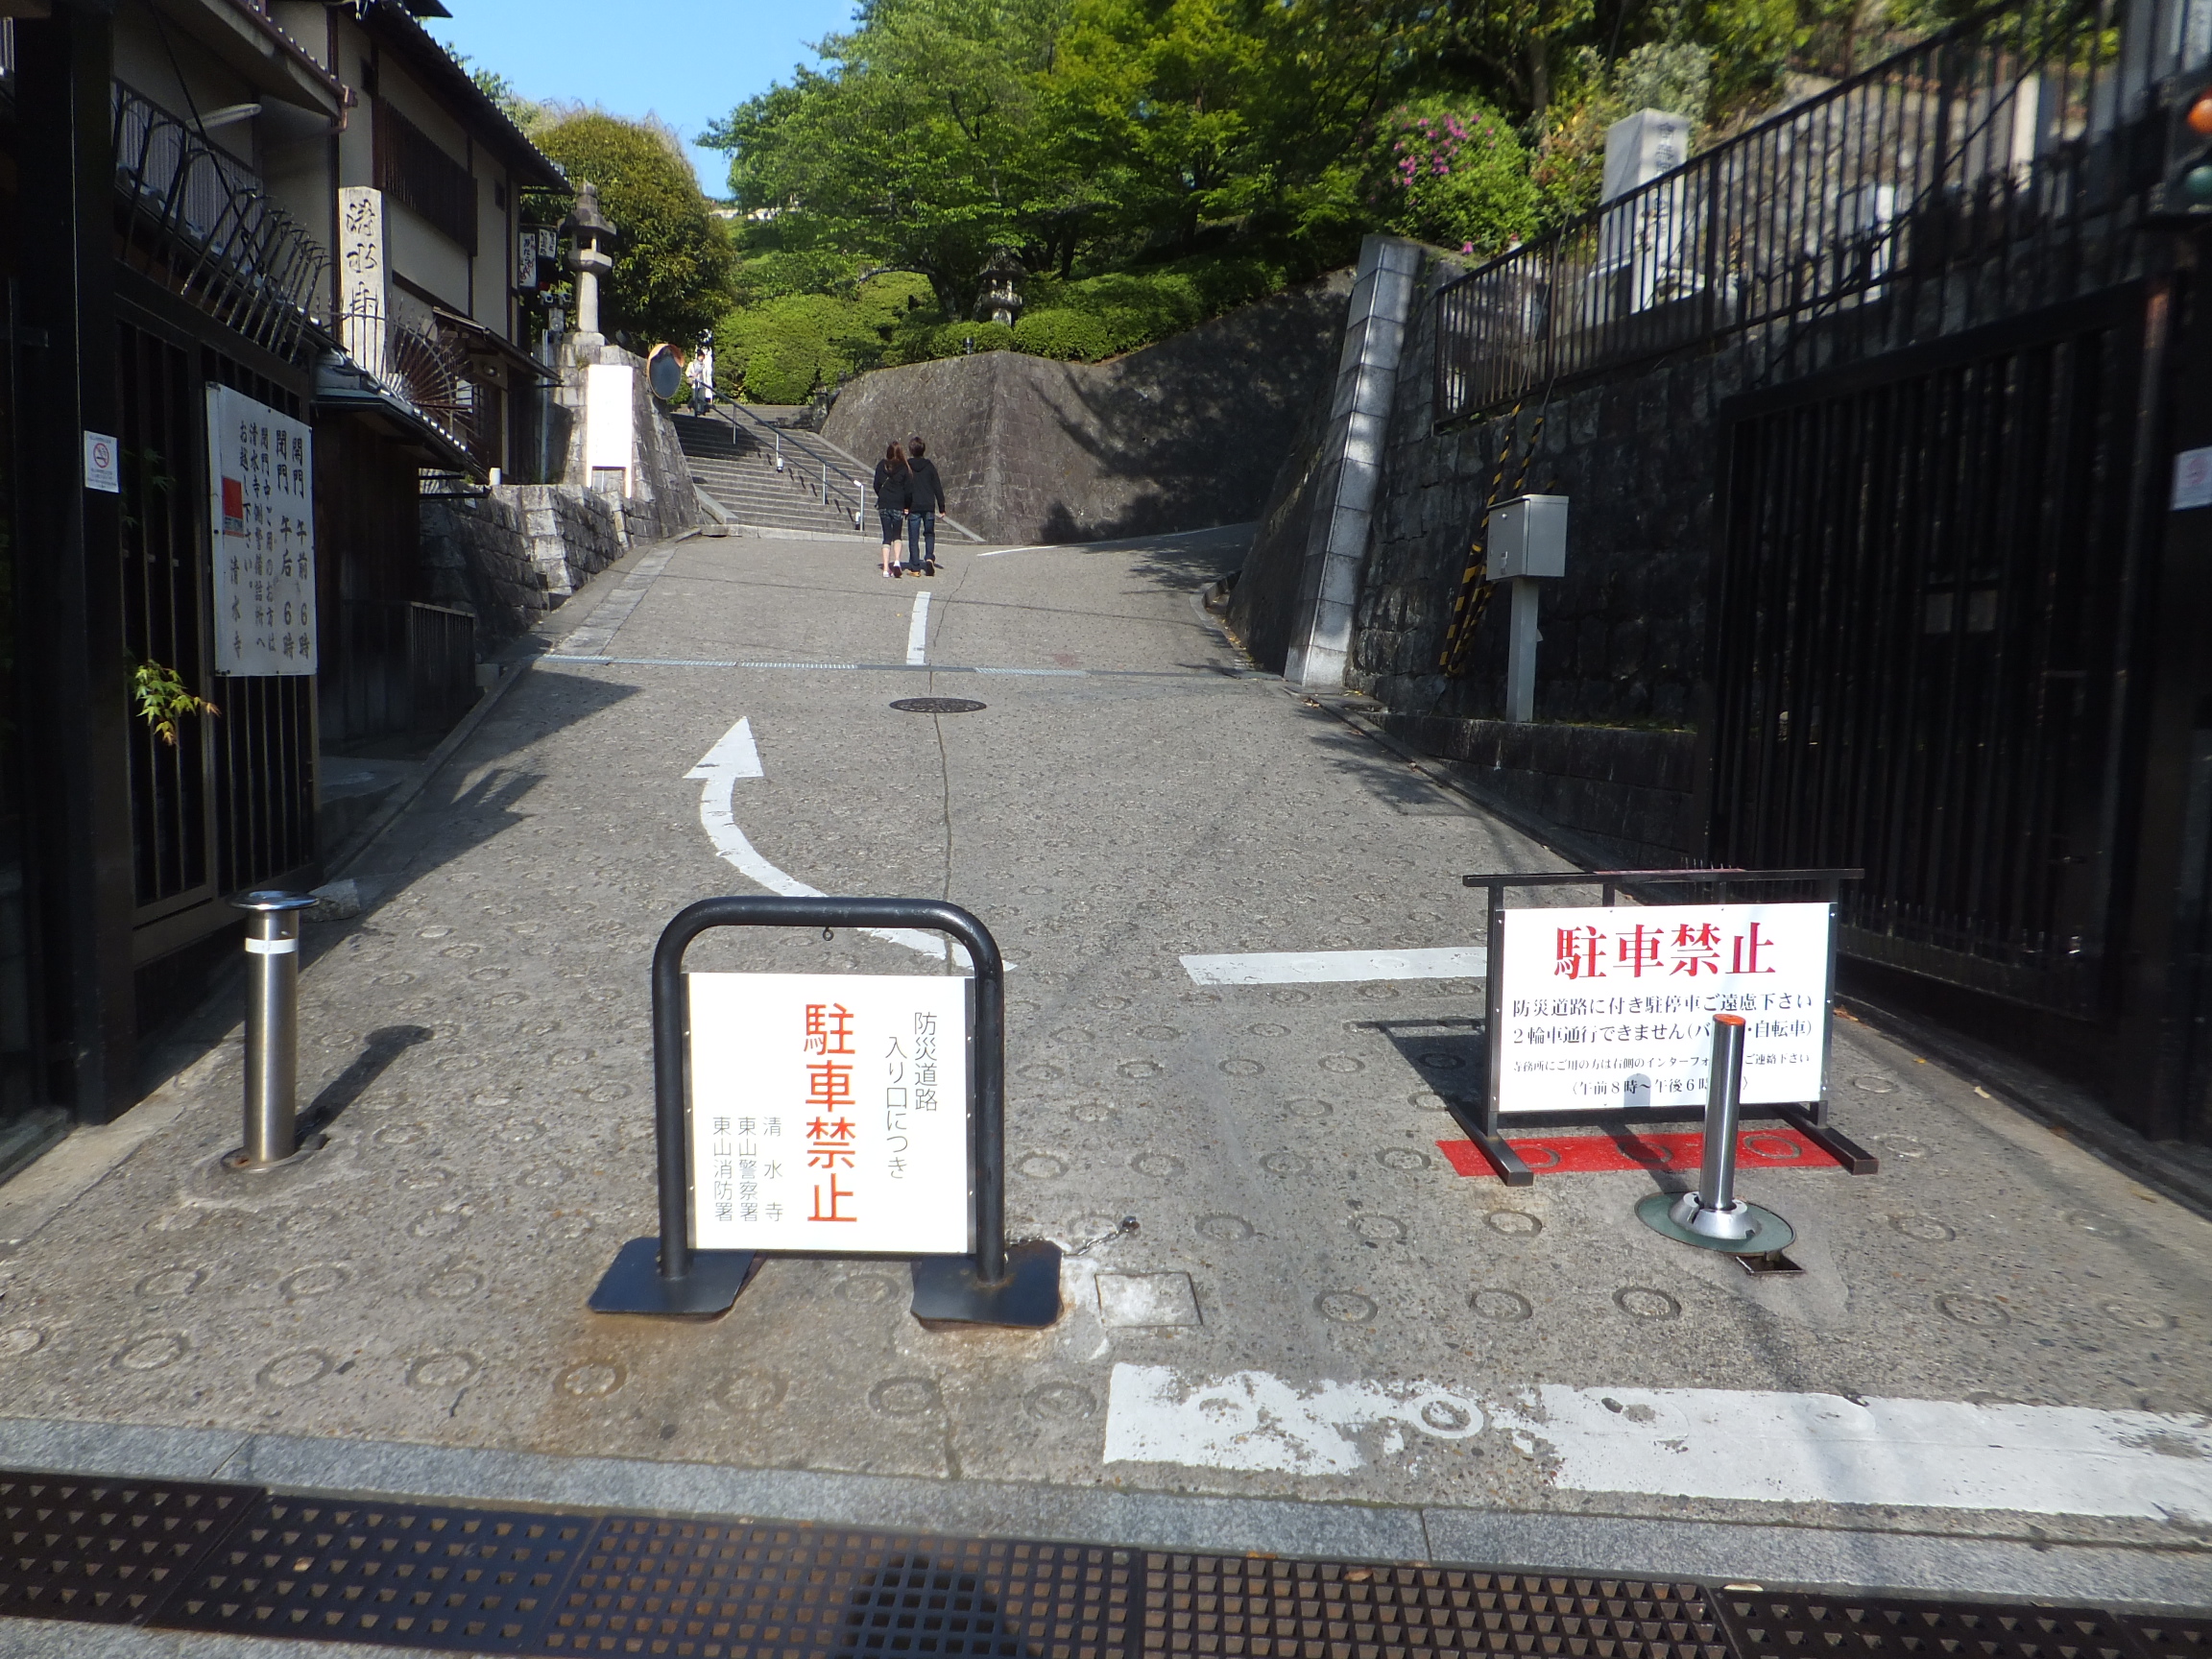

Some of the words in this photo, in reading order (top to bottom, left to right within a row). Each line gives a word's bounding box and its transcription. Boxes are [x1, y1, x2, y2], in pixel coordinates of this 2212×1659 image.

[276, 429, 289, 495] 閉門
[292, 438, 304, 500] 開門
[296, 519, 307, 580] 午前
[229, 555, 242, 661] 清水寺
[282, 601, 295, 661] 6時
[299, 602, 310, 661] 6時
[1553, 921, 1776, 980] 駐車禁止
[1512, 993, 1813, 1017] 防災道路に付き駐停車ご遠慮下さい
[1512, 1020, 1813, 1046] 2輪車通行できません(バ・自転車)
[914, 1011, 938, 1112] 防災道路
[804, 1001, 858, 1223] 駐車禁止
[884, 1036, 908, 1180] 入り口につき
[712, 1116, 733, 1222] 東山消防署
[737, 1116, 758, 1222] 東山警察署
[762, 1116, 783, 1222] 清水寺
